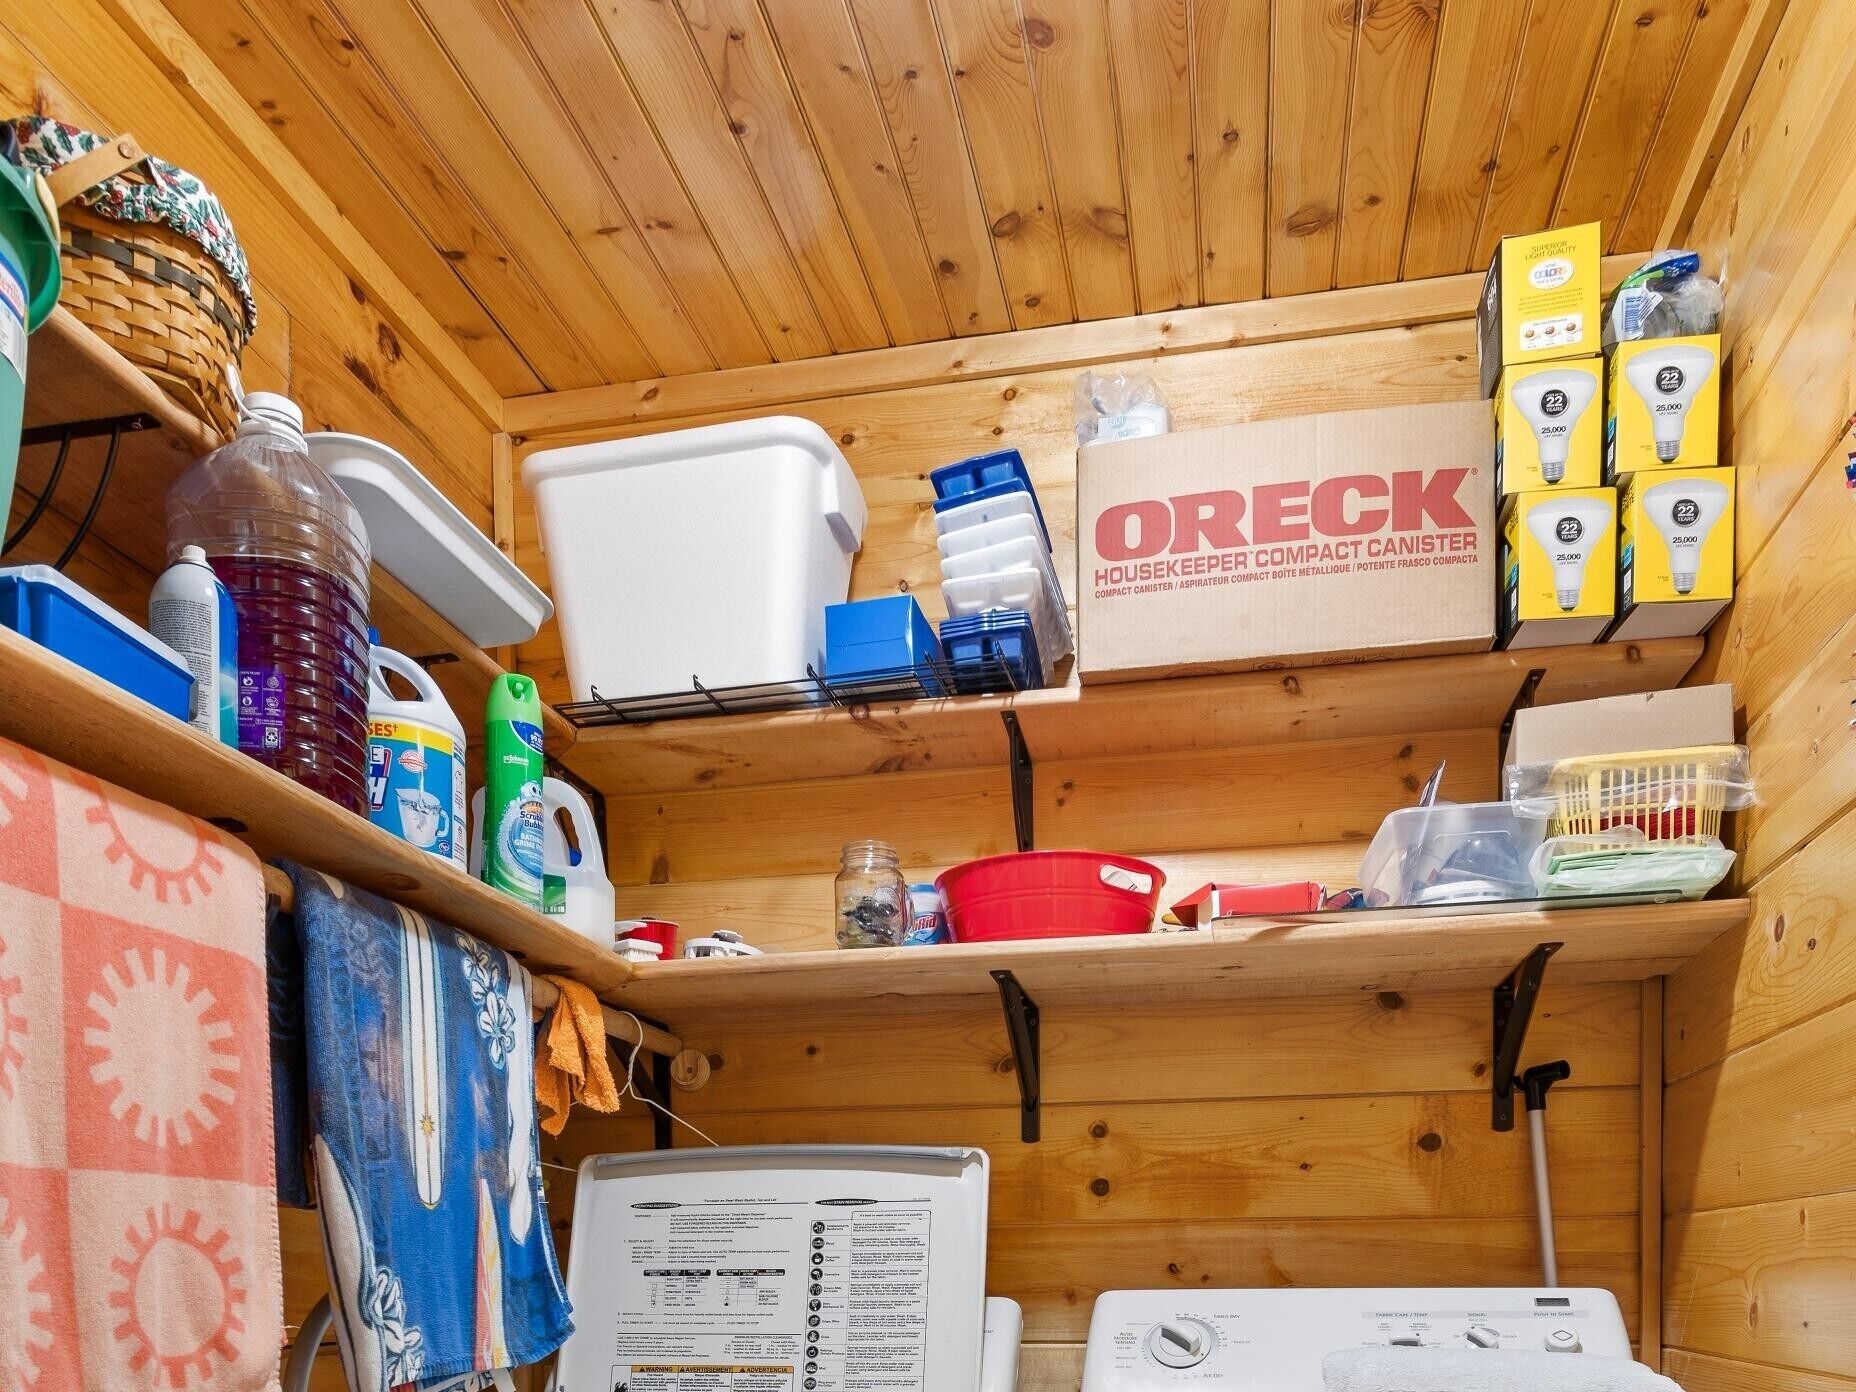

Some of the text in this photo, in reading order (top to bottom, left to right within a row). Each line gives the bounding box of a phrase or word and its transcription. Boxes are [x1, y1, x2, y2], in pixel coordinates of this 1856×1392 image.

[1532, 241, 1567, 252] SUPERIOR
[1525, 245, 1577, 261] LIGHT QUALITY
[1661, 373, 1679, 384] 22
[1546, 396, 1563, 407] 22
[1656, 403, 1682, 412] 25,000
[1541, 425, 1566, 434] 25,000
[1677, 506, 1695, 517] 22
[1561, 523, 1578, 535] 22
[1672, 536, 1698, 544] 25,000
[1255, 540, 1362, 568] COMPACT
[1367, 532, 1477, 558] CANISTER
[1556, 553, 1581, 561] 25,000
[1095, 588, 1132, 599] COMPACT
[1133, 583, 1173, 594] CANISTER
[1179, 576, 1229, 589] ASPIRATEUR
[1231, 571, 1270, 584] COMPACT
[1356, 561, 1396, 572] POTENTE
[1397, 557, 1431, 569] FRASCO
[1433, 554, 1478, 566] COMPACTA
